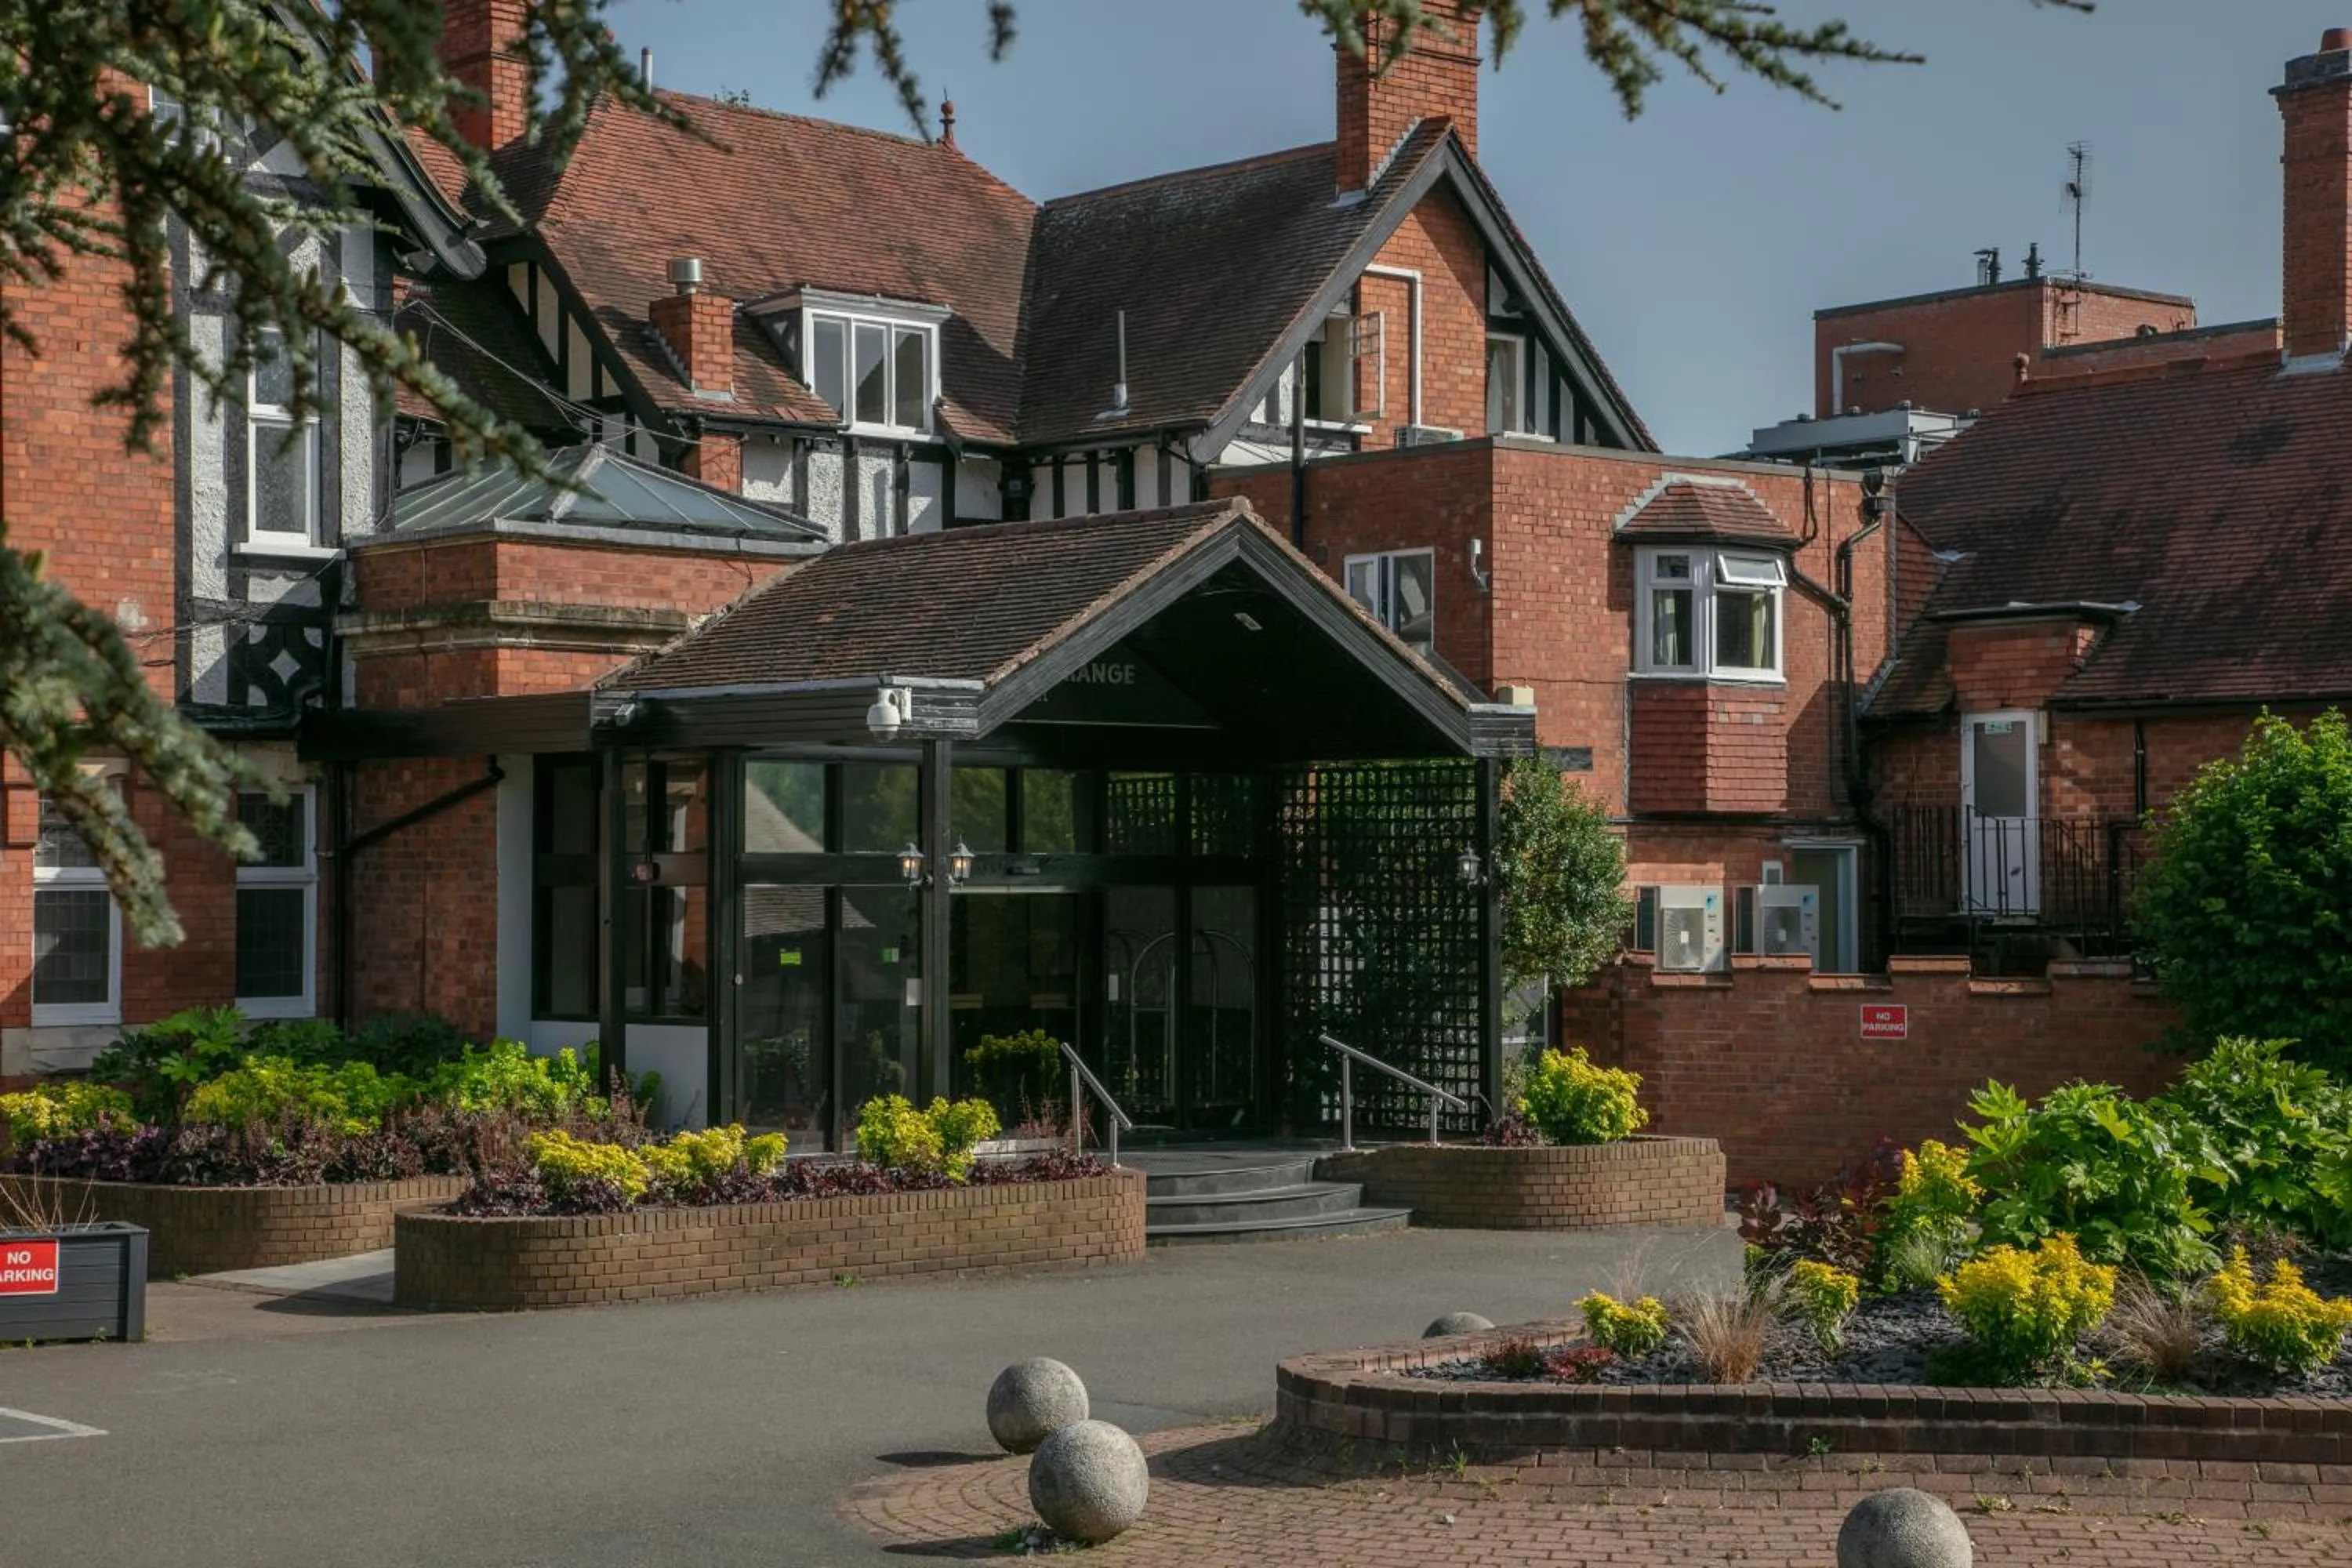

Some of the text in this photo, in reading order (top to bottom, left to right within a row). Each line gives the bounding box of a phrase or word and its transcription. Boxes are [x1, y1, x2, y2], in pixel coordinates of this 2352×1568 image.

[1876, 1011, 1890, 1021] NO
[1863, 1022, 1904, 1032] PARKING
[7, 1250, 31, 1265] NO
